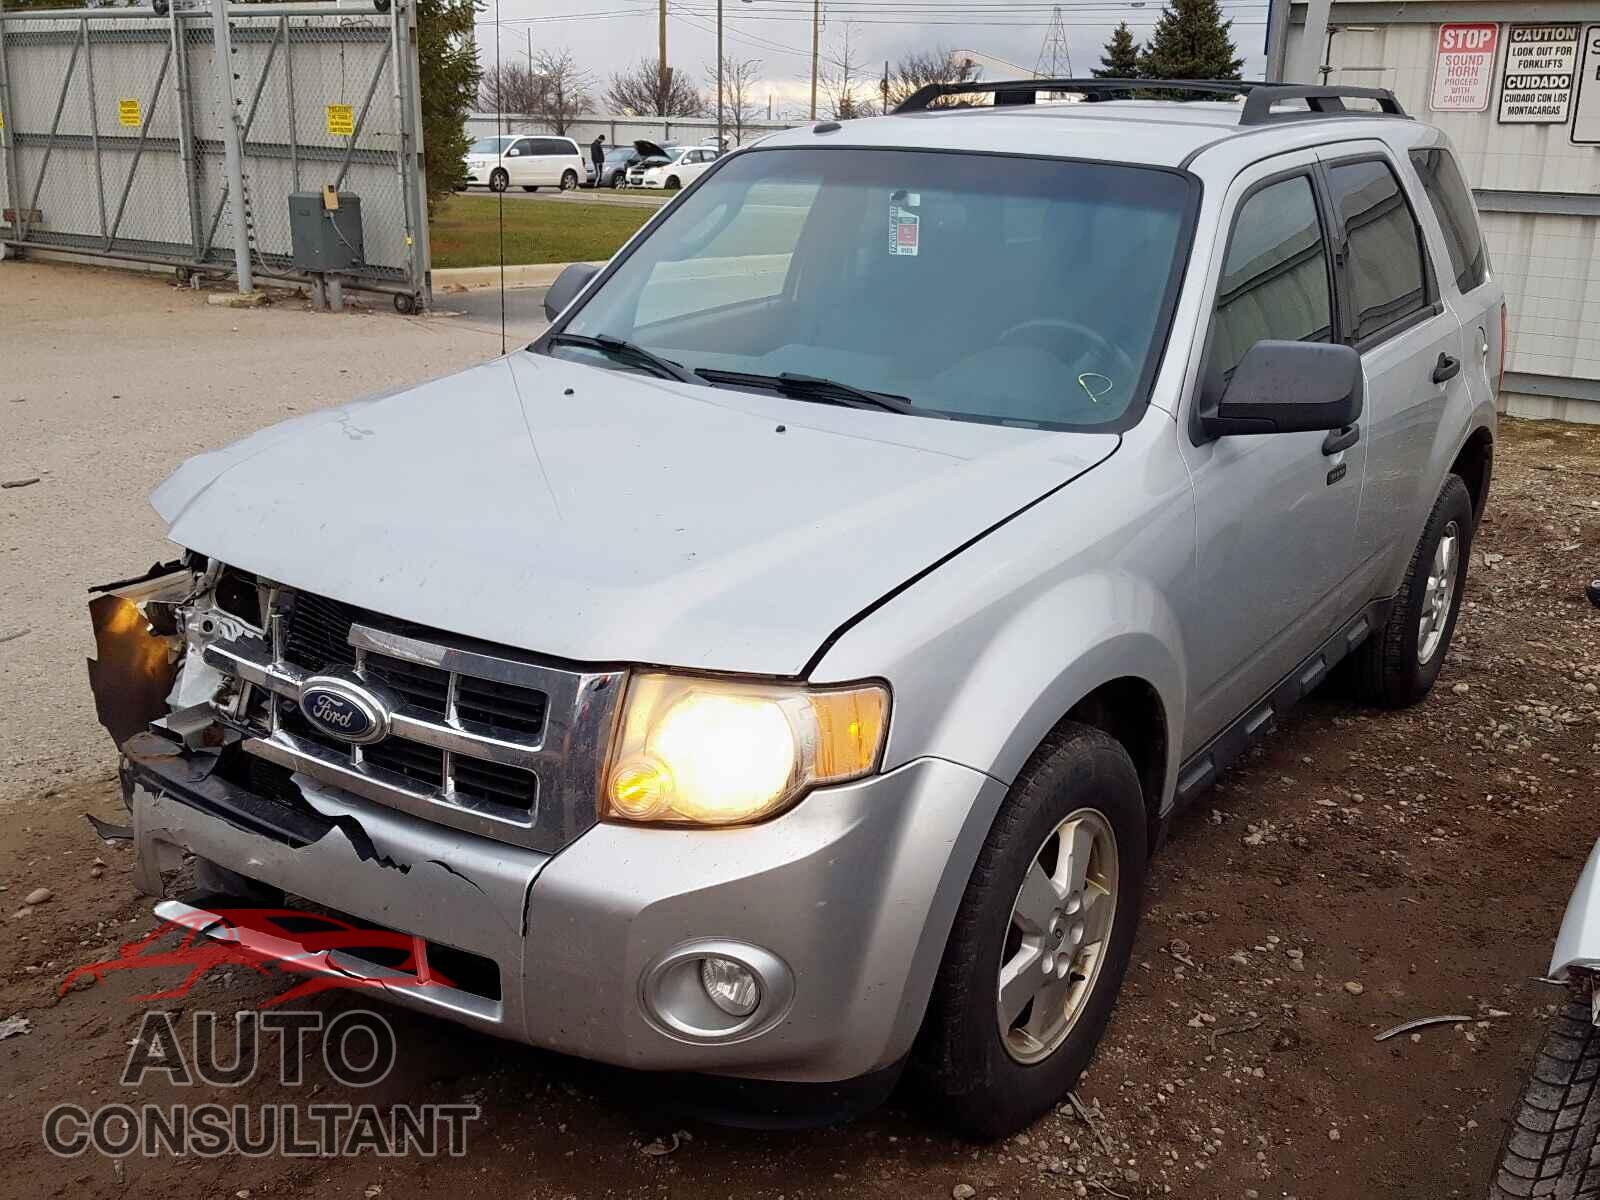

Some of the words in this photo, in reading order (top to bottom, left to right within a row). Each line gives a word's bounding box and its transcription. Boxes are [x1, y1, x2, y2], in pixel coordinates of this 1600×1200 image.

[1442, 29, 1492, 49] STOP
[1512, 28, 1576, 41] CAUTION
[1512, 47, 1534, 57] LOOK
[1536, 46, 1554, 56] OUT
[1555, 46, 1573, 56] FOR
[1445, 55, 1484, 66] SOUND
[1517, 59, 1563, 69] FORKLIFTS
[1447, 66, 1479, 77] HORN
[1444, 78, 1479, 86] PROCEED
[1506, 75, 1570, 89] CUIDADO
[1443, 95, 1475, 104] CAUTION
[1504, 93, 1535, 103] CUIDADO
[1537, 93, 1552, 103] CON
[1554, 93, 1568, 103] LOS
[1507, 105, 1561, 116] MONTACARGAS
[313, 694, 353, 727] Ford
